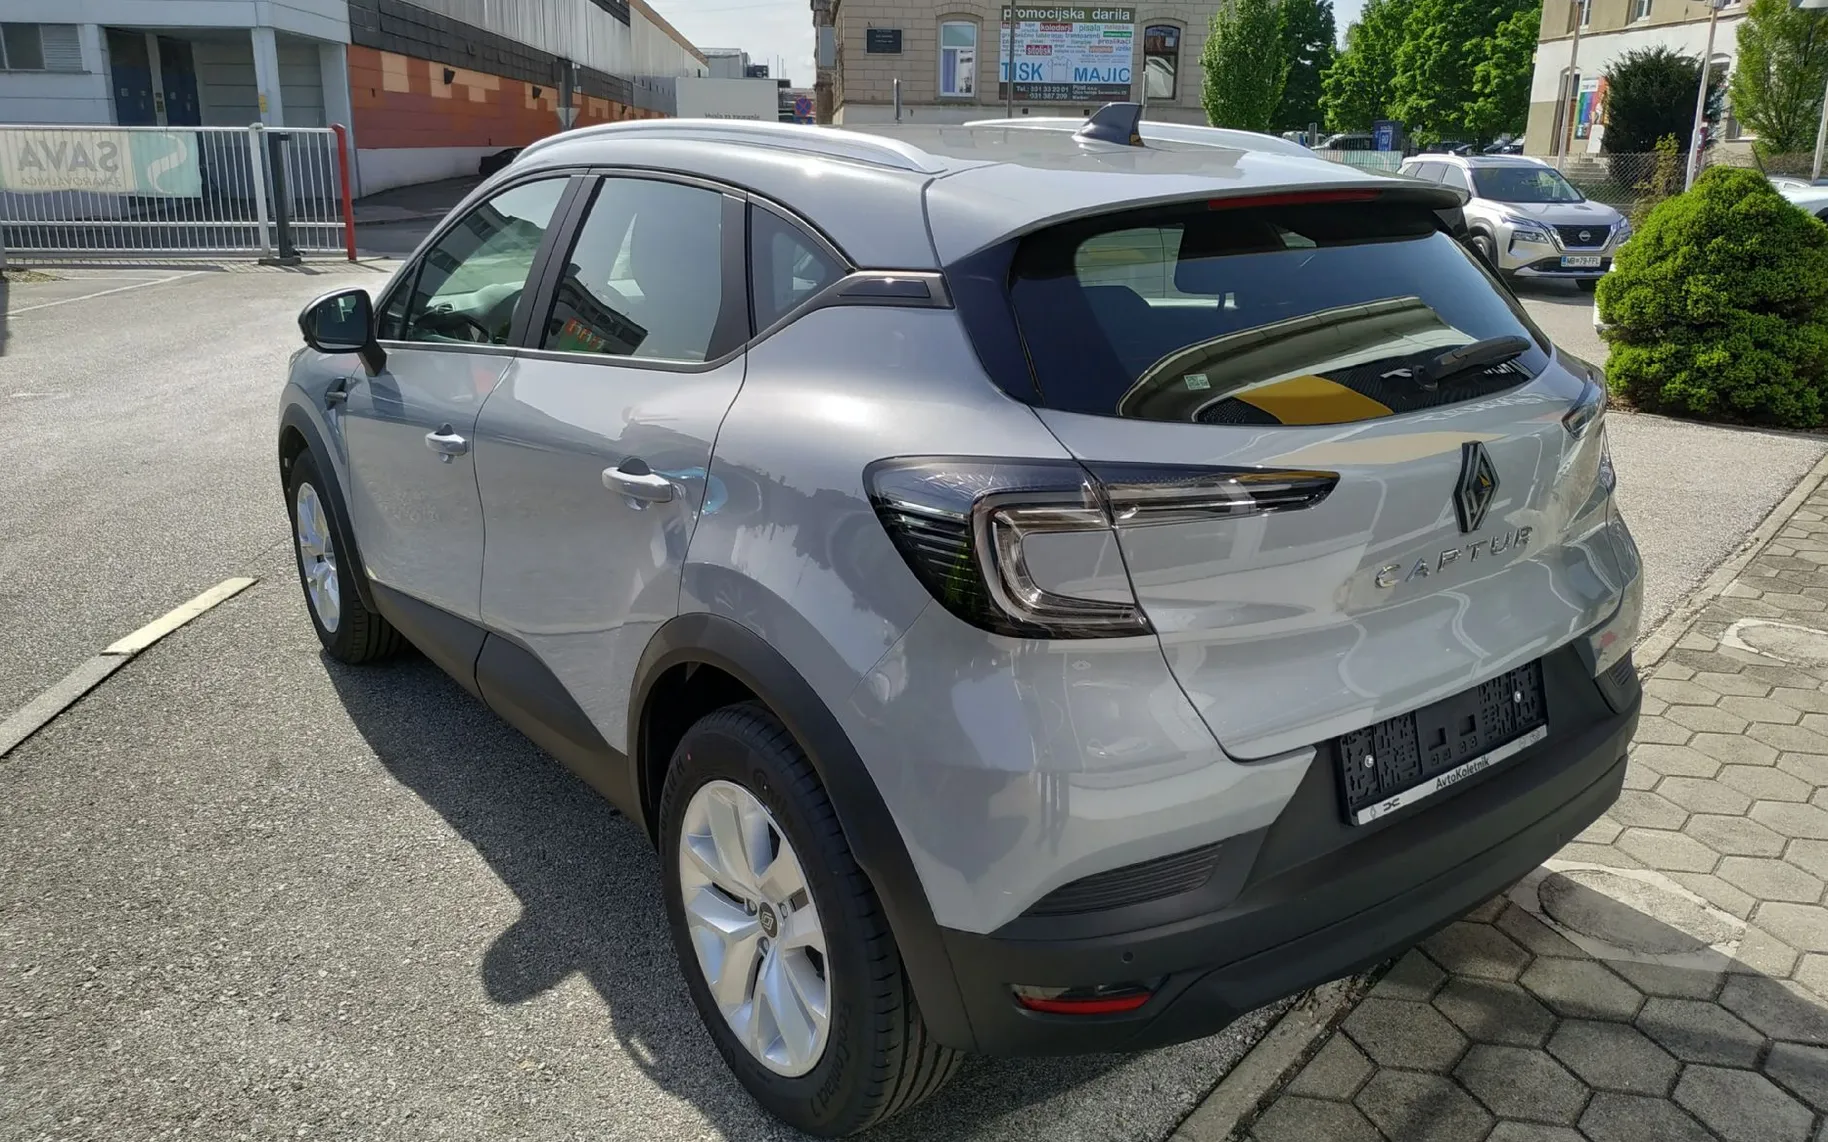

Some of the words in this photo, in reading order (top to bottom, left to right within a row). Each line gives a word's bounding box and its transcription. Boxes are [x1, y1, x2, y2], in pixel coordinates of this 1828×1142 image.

[1092, 8, 1130, 20] darila
[1001, 62, 1043, 81] TISK
[1074, 67, 1130, 82] MAJIC
[1375, 526, 1533, 589] CAPTUR
[1435, 755, 1490, 790] AvtoKoletnik
